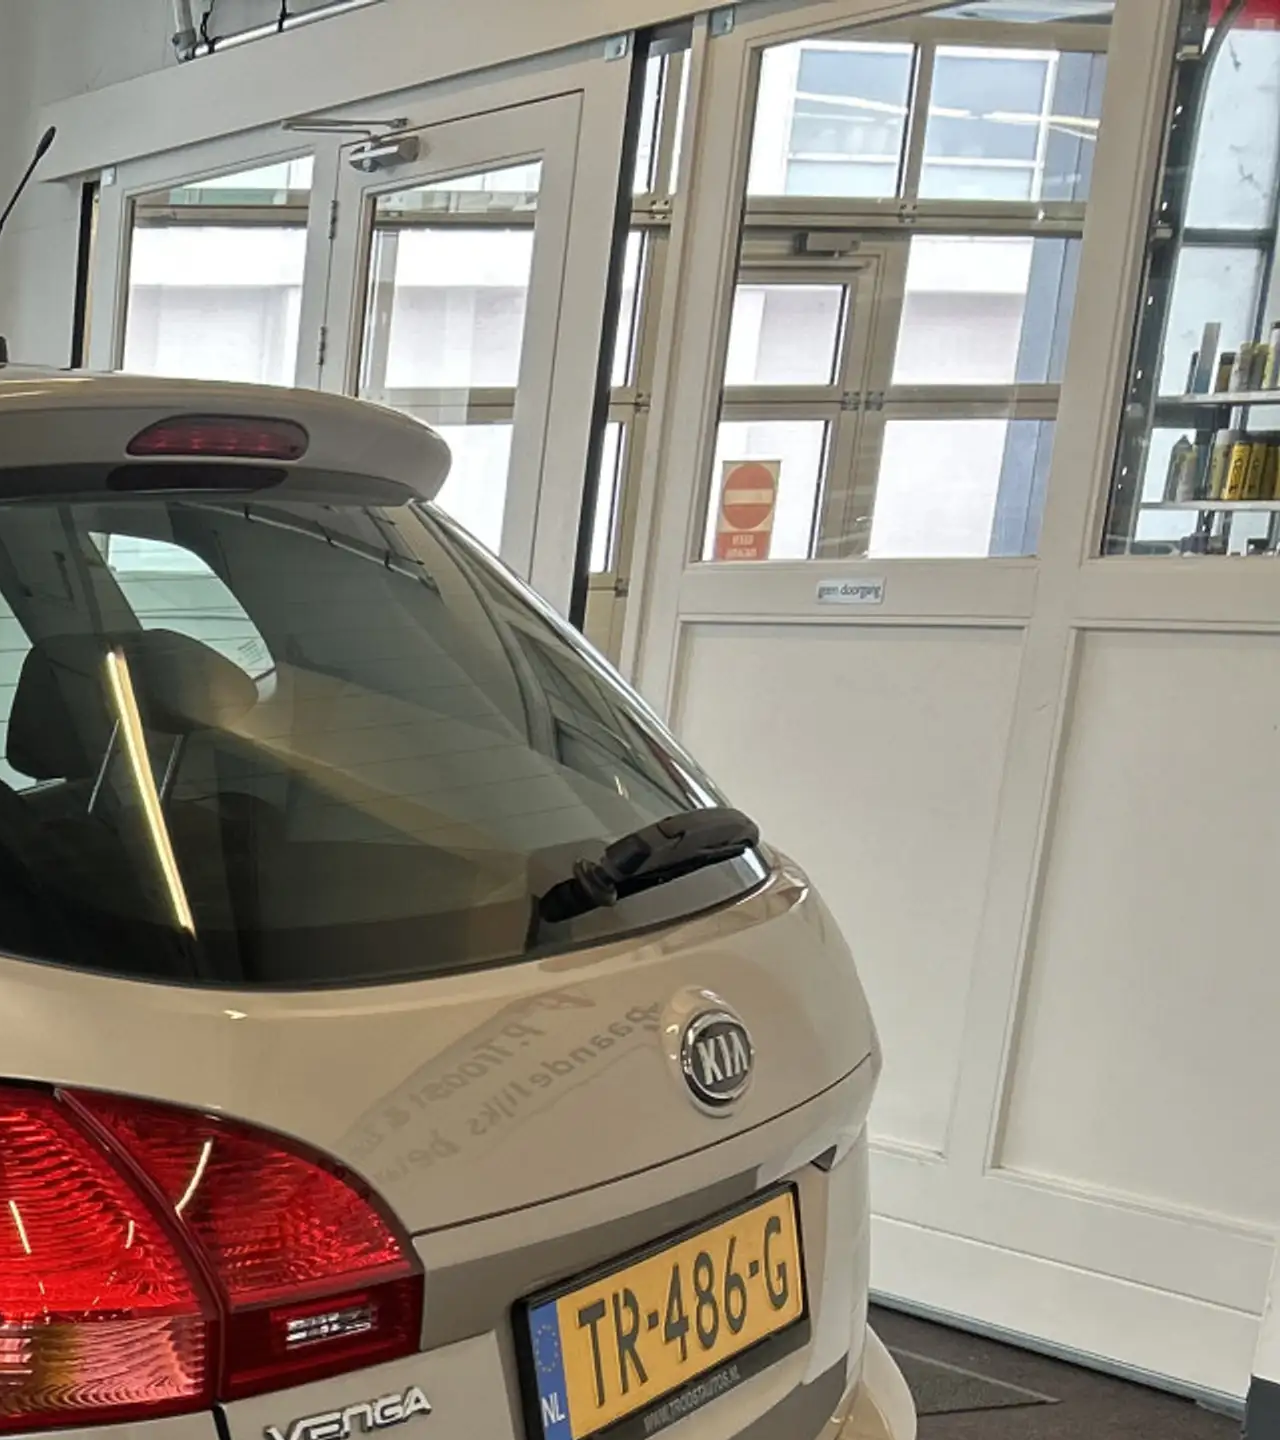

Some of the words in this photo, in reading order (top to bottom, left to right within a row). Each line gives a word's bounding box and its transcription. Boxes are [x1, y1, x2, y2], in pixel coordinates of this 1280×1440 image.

[696, 1031, 749, 1085] KIA
[577, 1215, 789, 1409] TR-486-G
[541, 1392, 565, 1427] NL
